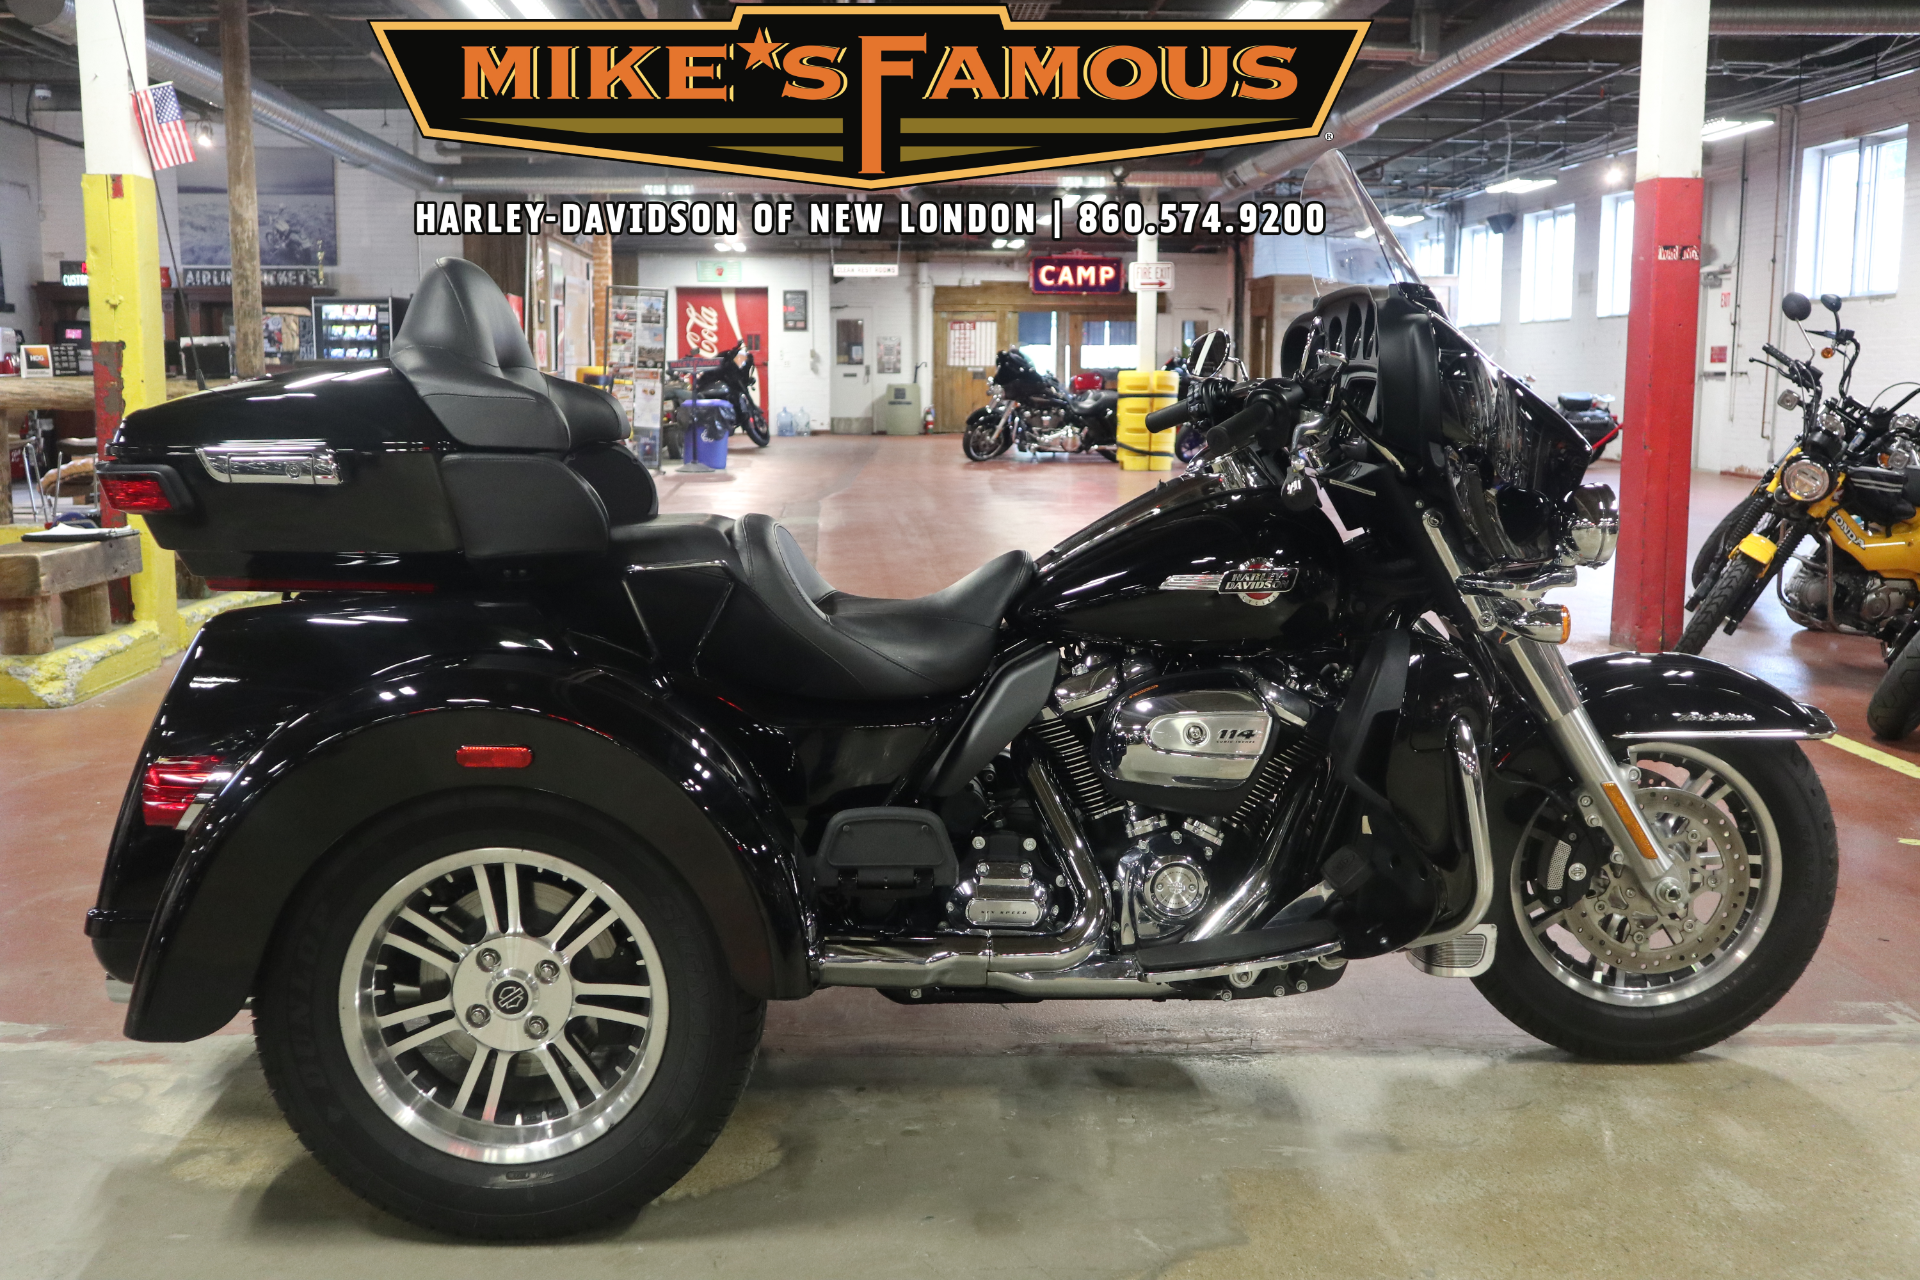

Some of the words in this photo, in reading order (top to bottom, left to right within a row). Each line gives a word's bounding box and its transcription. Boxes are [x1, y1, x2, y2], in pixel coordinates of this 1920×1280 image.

[836, 266, 855, 274] CLEAN
[857, 266, 873, 274] REST
[874, 266, 896, 274] ROOMS
[1038, 264, 1116, 287] CAMP
[1136, 266, 1152, 280] FIRE
[1155, 266, 1171, 280] EXIT
[686, 301, 719, 359] Cola
[1225, 580, 1290, 590] DAVIDSON
[1217, 729, 1256, 740] 114
